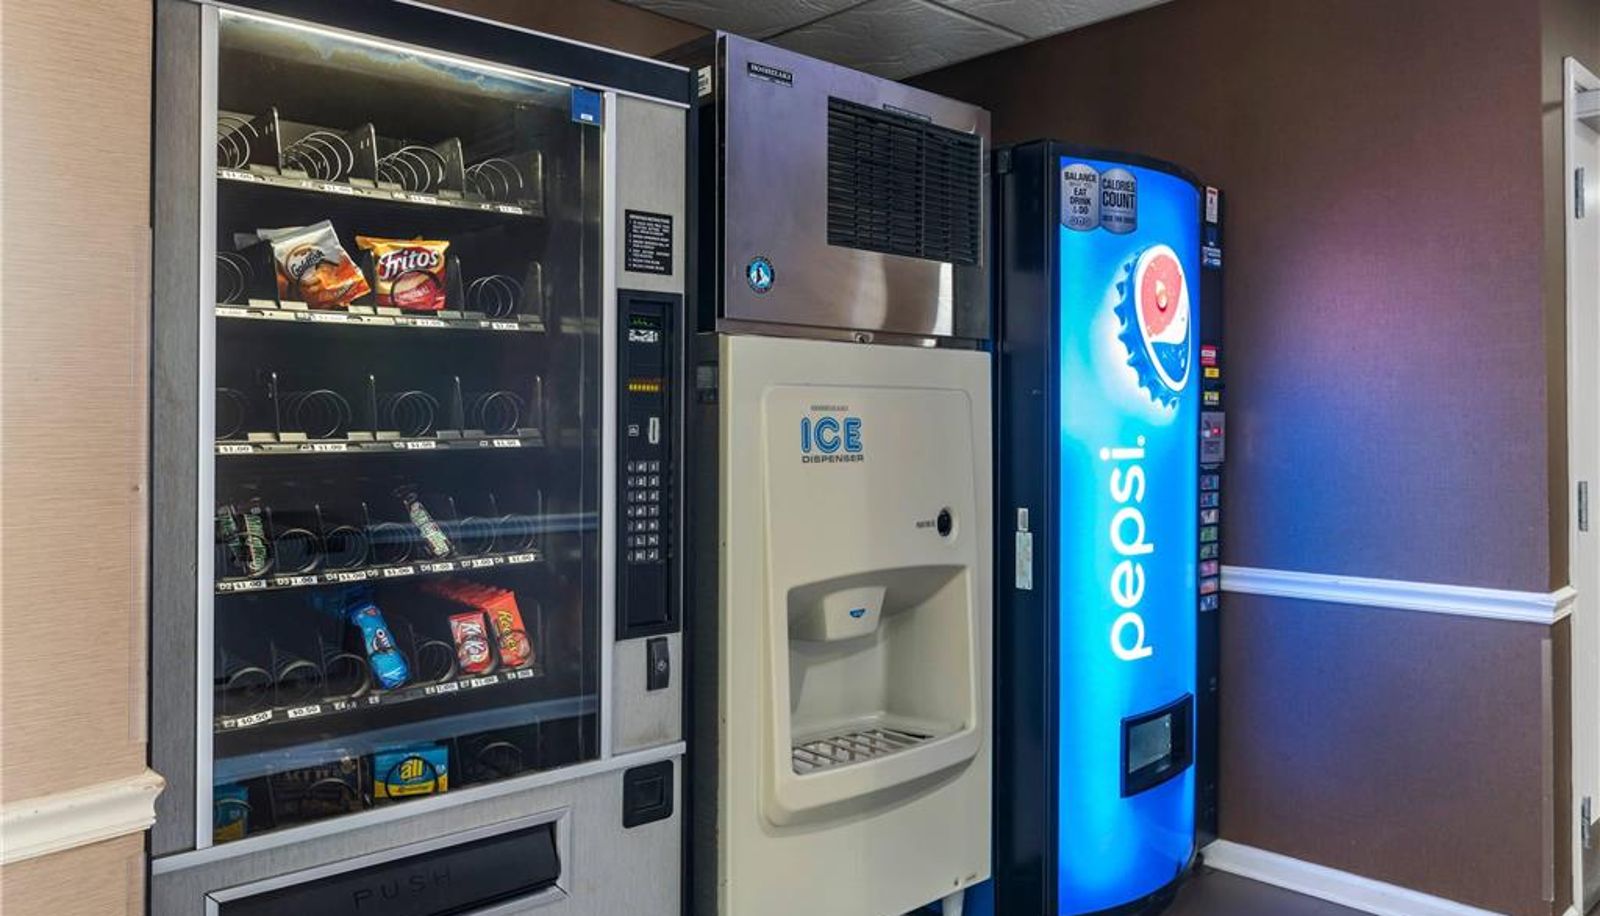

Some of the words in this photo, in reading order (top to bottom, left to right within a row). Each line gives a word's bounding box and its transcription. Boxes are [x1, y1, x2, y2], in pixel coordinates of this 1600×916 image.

[1064, 171, 1097, 183] BALANCE
[1073, 187, 1088, 196] EAT
[1102, 179, 1135, 192] CALORIES
[1069, 196, 1091, 206] DRINK
[1102, 190, 1136, 209] COUNT
[378, 250, 440, 281] Fritos
[801, 416, 863, 453] ICE
[802, 454, 864, 463] DISPENSER
[239, 712, 269, 725] $0.50
[401, 759, 424, 780] all
[352, 864, 451, 910] PUSH
